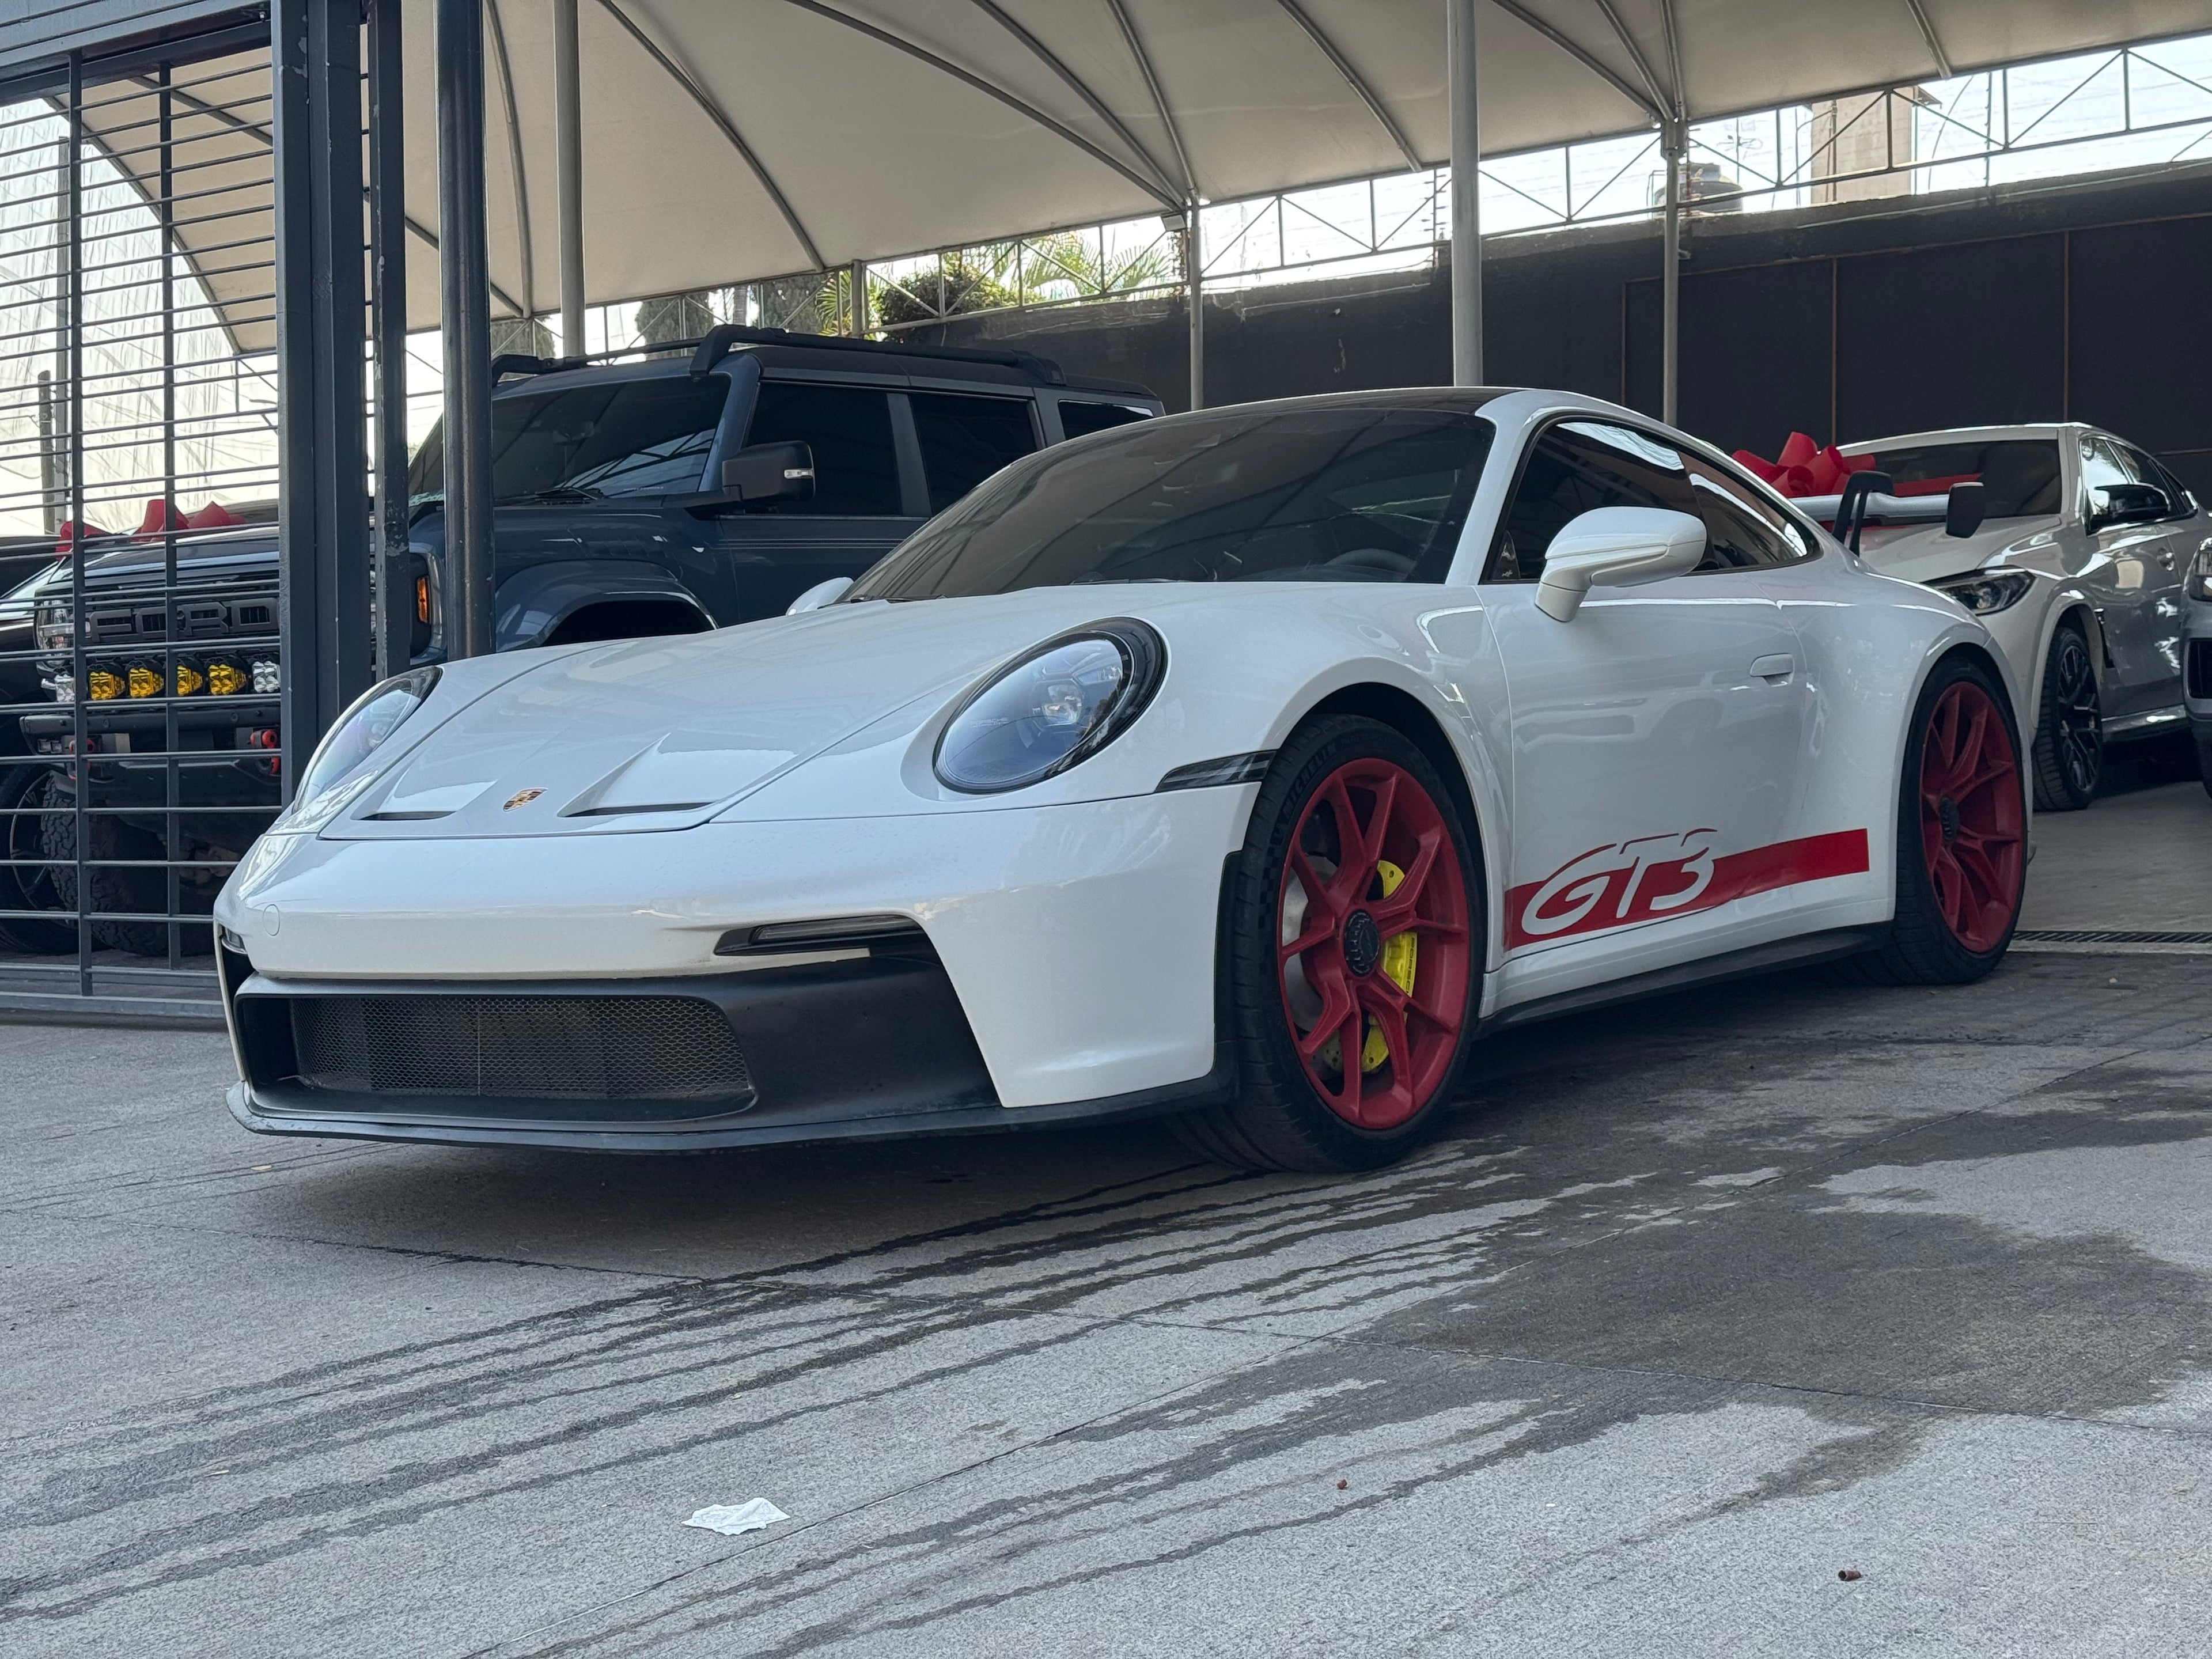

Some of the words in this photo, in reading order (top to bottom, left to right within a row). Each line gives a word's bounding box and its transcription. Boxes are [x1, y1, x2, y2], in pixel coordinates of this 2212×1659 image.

[90, 597, 279, 643] FORD
[1282, 742, 1338, 819] MICHELIN
[1522, 828, 1718, 935] GT3
[1406, 937, 1415, 994] PORSC
